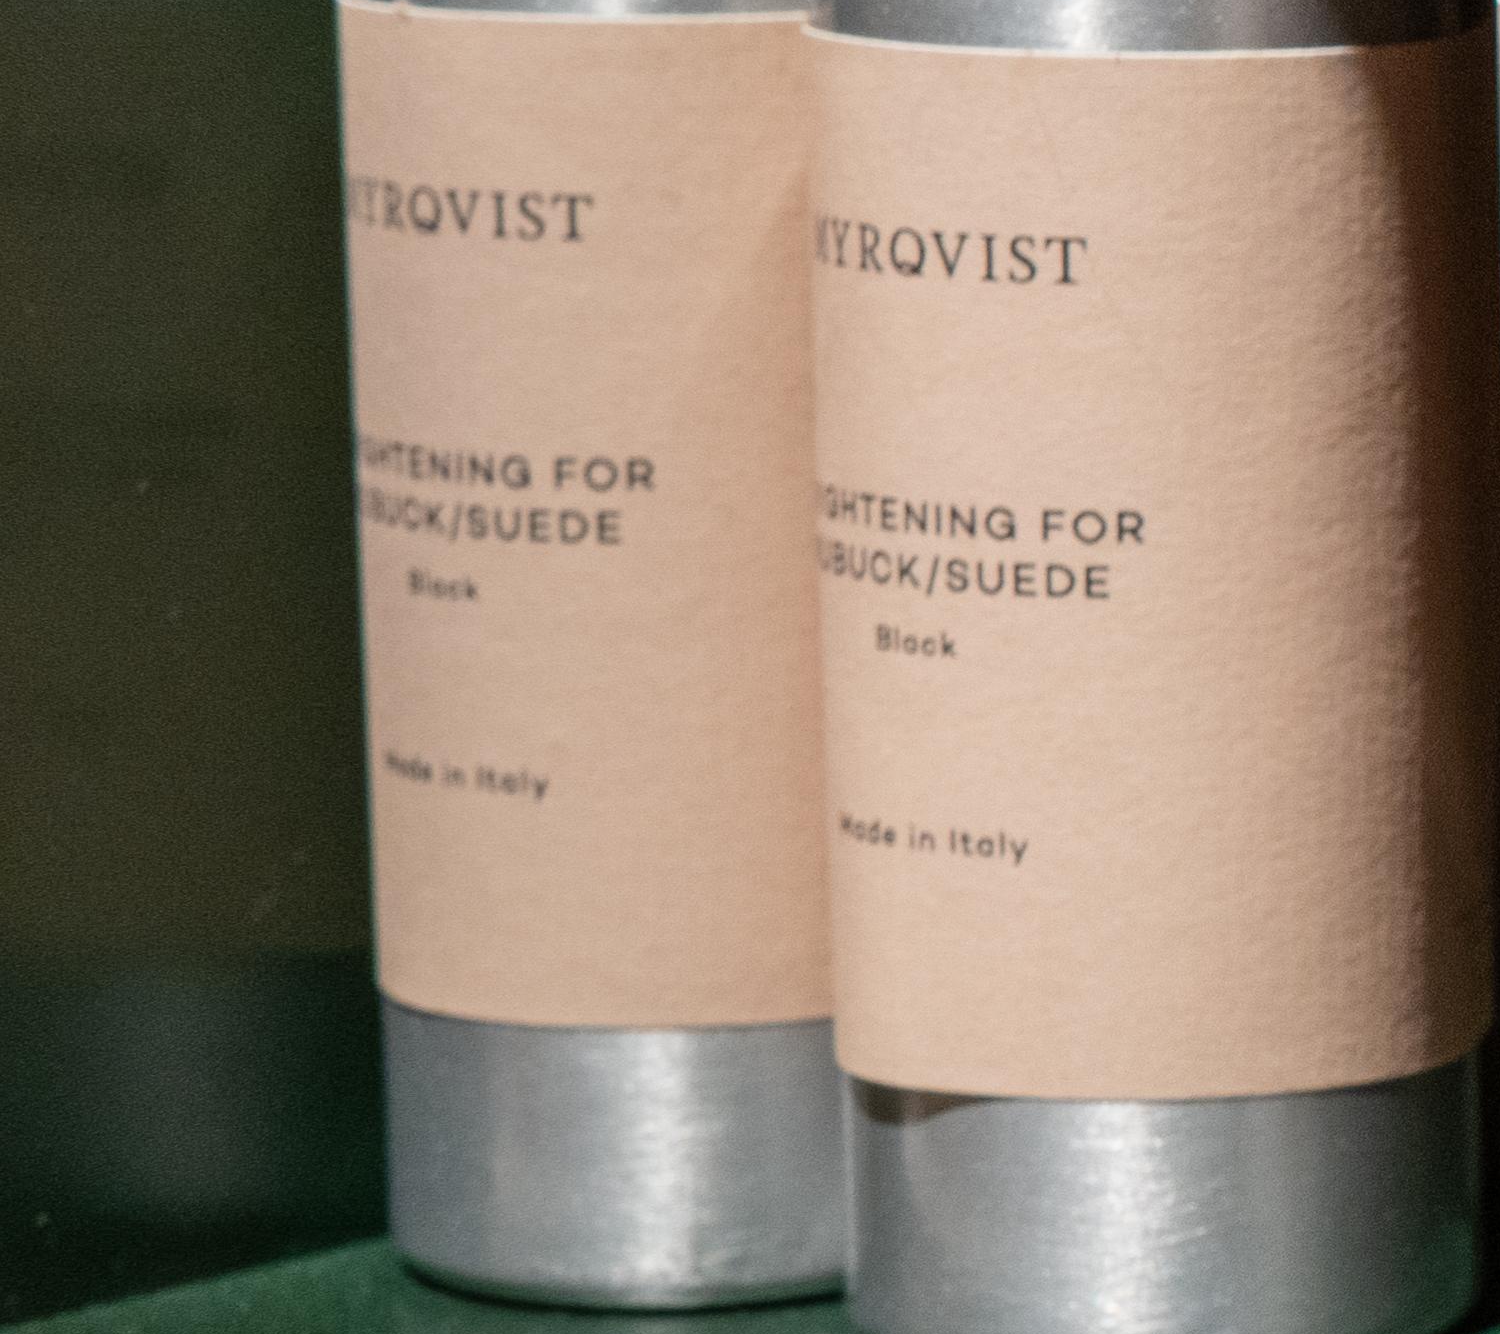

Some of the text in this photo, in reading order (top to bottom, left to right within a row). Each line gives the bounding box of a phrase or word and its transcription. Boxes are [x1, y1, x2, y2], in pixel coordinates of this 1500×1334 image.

[350, 175, 596, 243] YRQVIST
[552, 453, 656, 493] FOR
[1041, 508, 1146, 545] FOR
[875, 622, 957, 659] Black
[907, 820, 937, 852] in
[948, 827, 1029, 868] Italy
